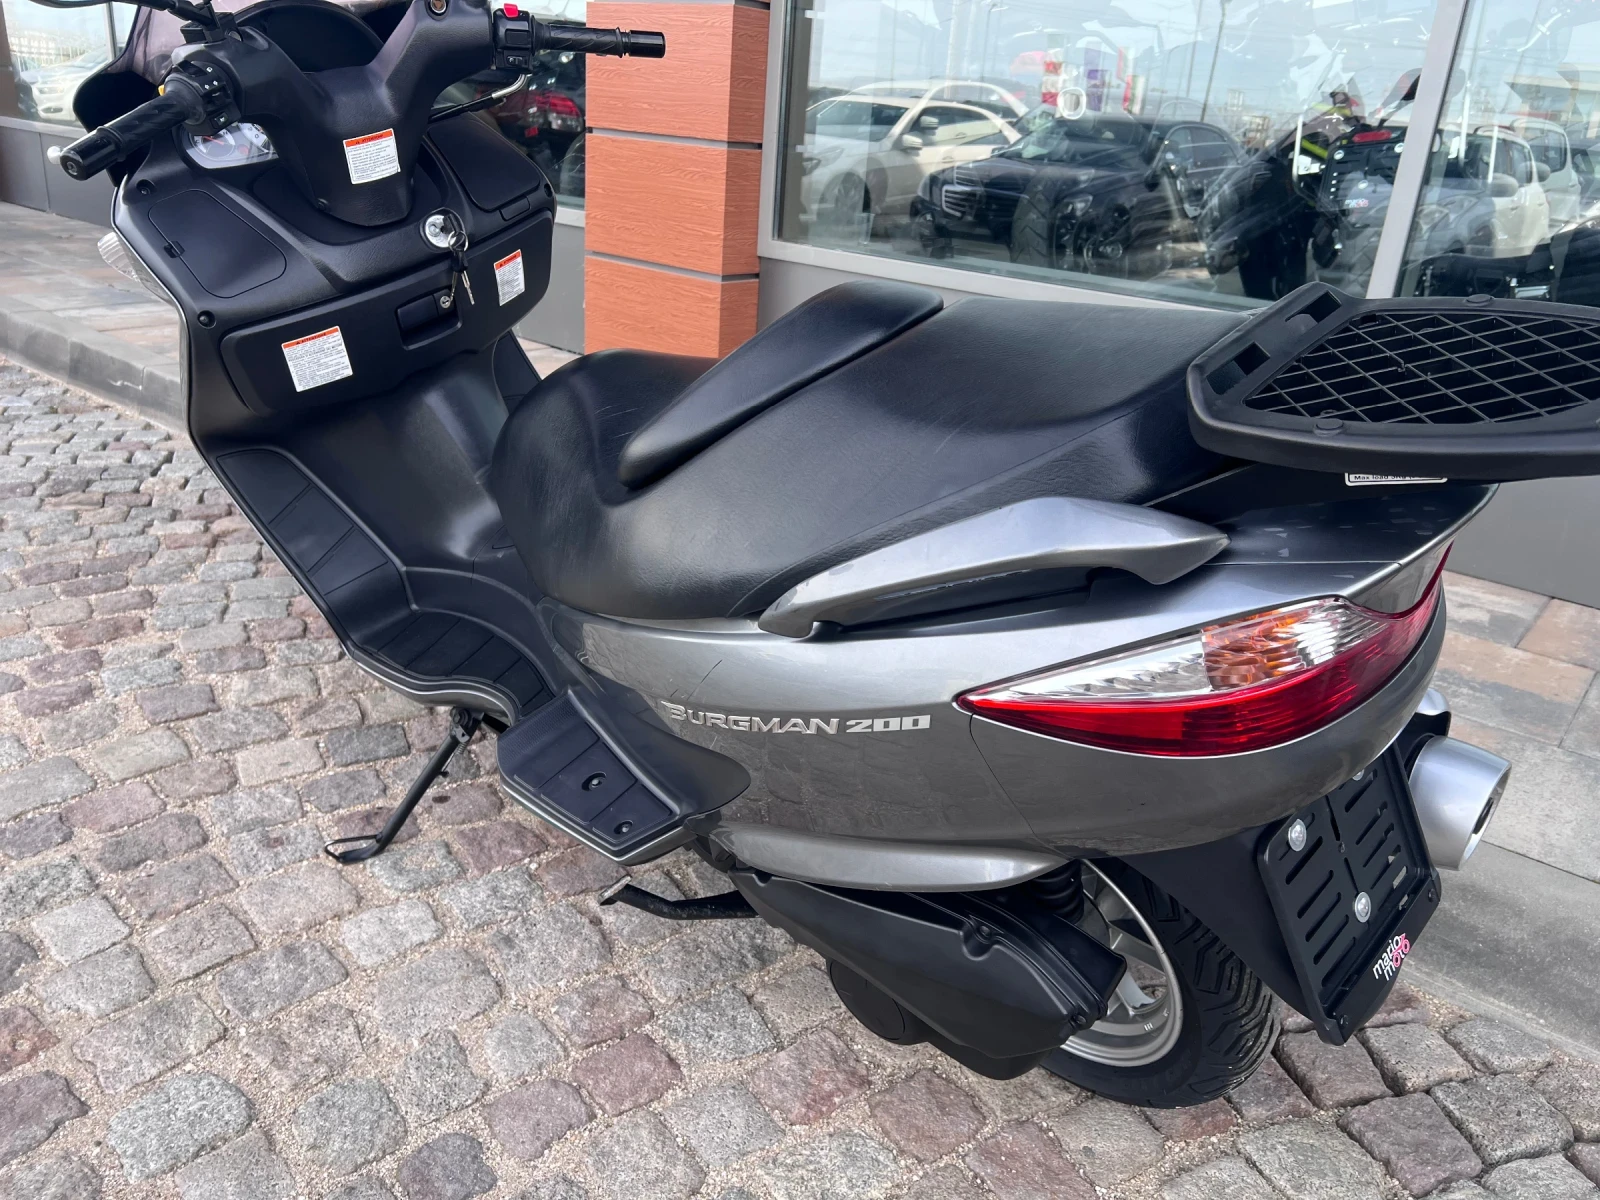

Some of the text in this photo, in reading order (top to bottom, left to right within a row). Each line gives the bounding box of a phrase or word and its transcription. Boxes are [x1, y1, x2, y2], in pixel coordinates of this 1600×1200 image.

[660, 700, 932, 735] BURGMAN 200
[1372, 935, 1401, 980] mario
[1384, 939, 1411, 981] moto
